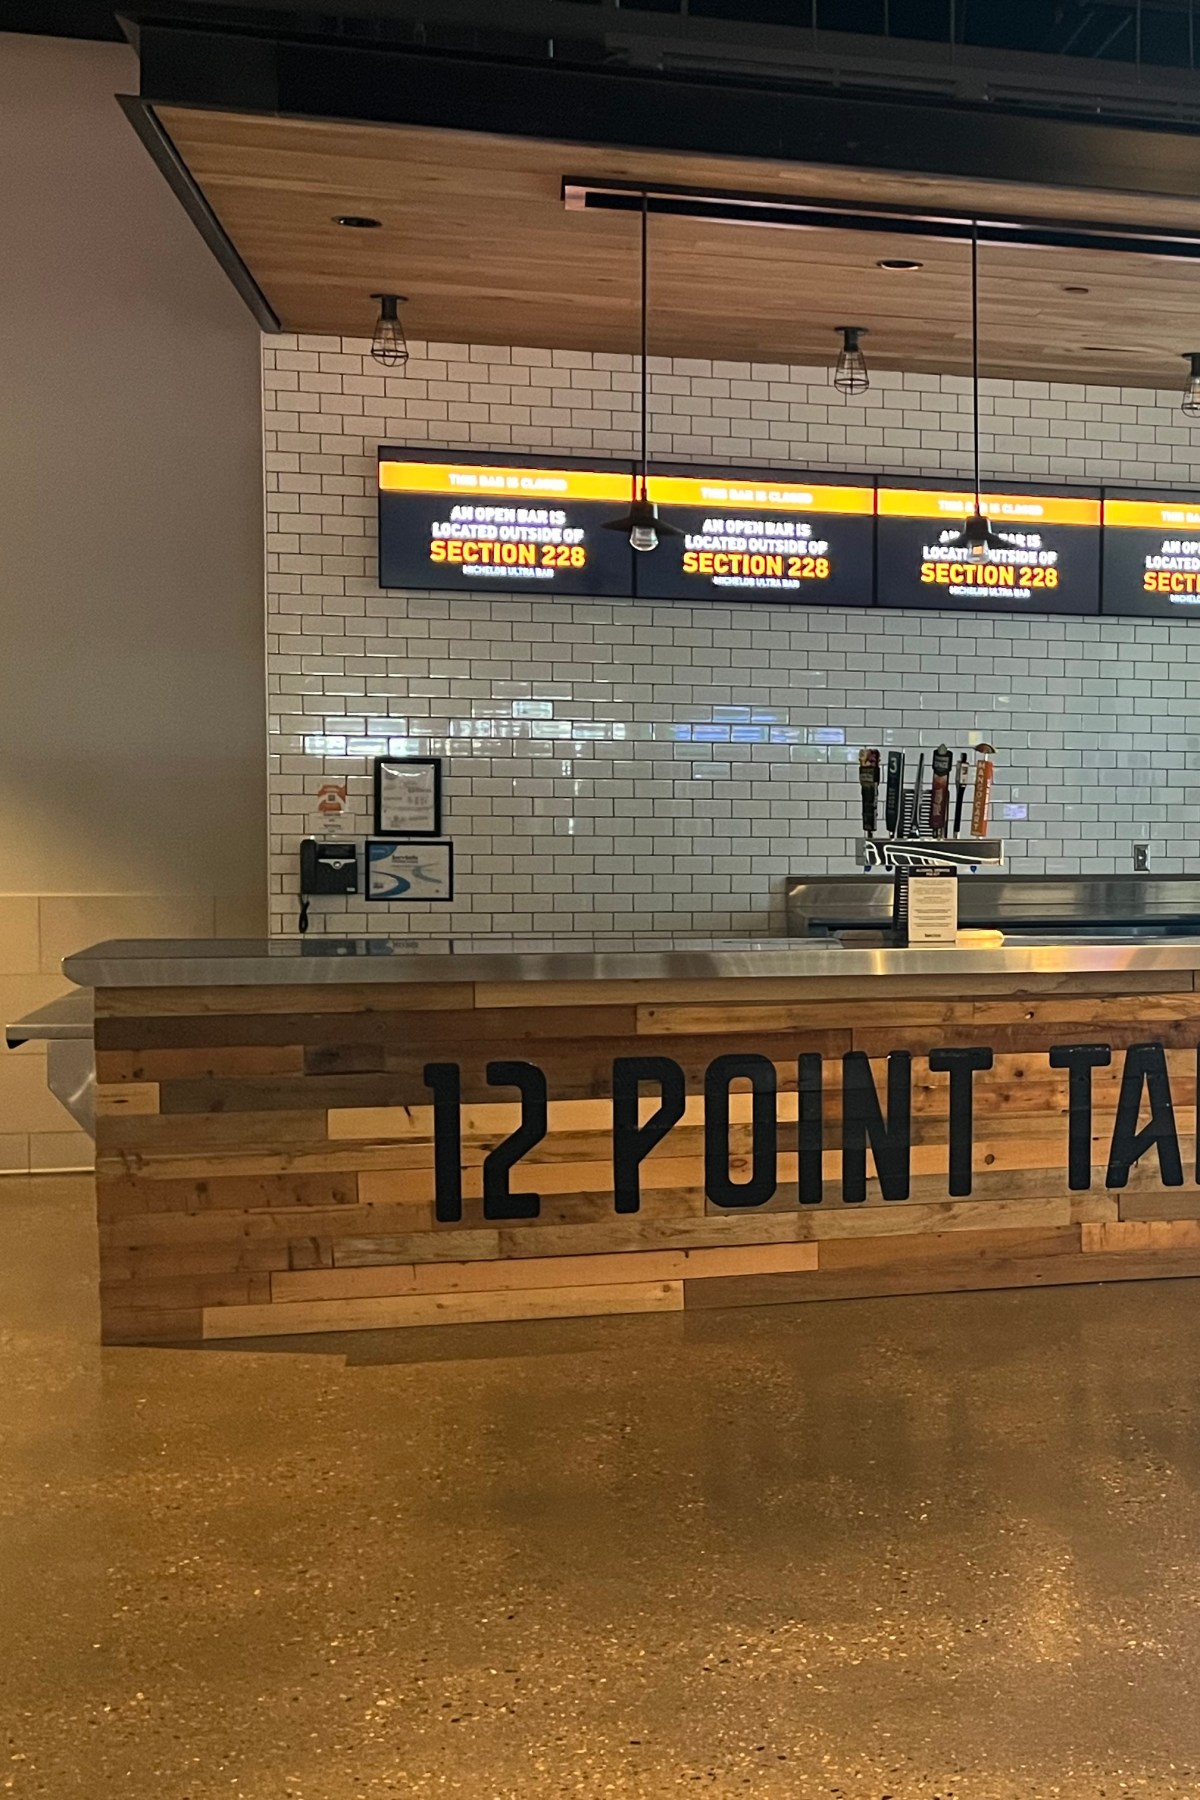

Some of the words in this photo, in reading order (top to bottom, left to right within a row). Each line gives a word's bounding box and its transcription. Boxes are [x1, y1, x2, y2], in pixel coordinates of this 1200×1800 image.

[451, 505, 474, 521] AN
[474, 507, 516, 522] OPEN
[516, 508, 548, 524] BAR
[549, 510, 566, 525] IS
[432, 522, 498, 539] LOCATED
[499, 525, 562, 542] OUTSIDE
[562, 528, 584, 543] OF
[702, 518, 725, 533] AN
[725, 520, 764, 534] OPEN
[764, 522, 795, 536] BAR
[795, 524, 812, 537] IS
[684, 534, 747, 550] LOCATED
[748, 538, 807, 554] OUTSIDE
[808, 540, 829, 555] OF
[1026, 535, 1042, 549] IS
[1161, 540, 1181, 554] AN
[430, 540, 536, 565] SECTION
[541, 545, 586, 567] 228
[985, 548, 1038, 564] UTSIDE
[1038, 550, 1059, 565] OF
[1145, 555, 1200, 571] LOCATED
[682, 551, 783, 577] SECTION
[787, 556, 830, 578] 228
[920, 562, 1015, 587] SECTION
[1018, 566, 1059, 588] 228
[889, 757, 898, 773] 3
[973, 801, 982, 831] CART
[423, 1061, 547, 1222] 12
[612, 1047, 993, 1213] POINT
